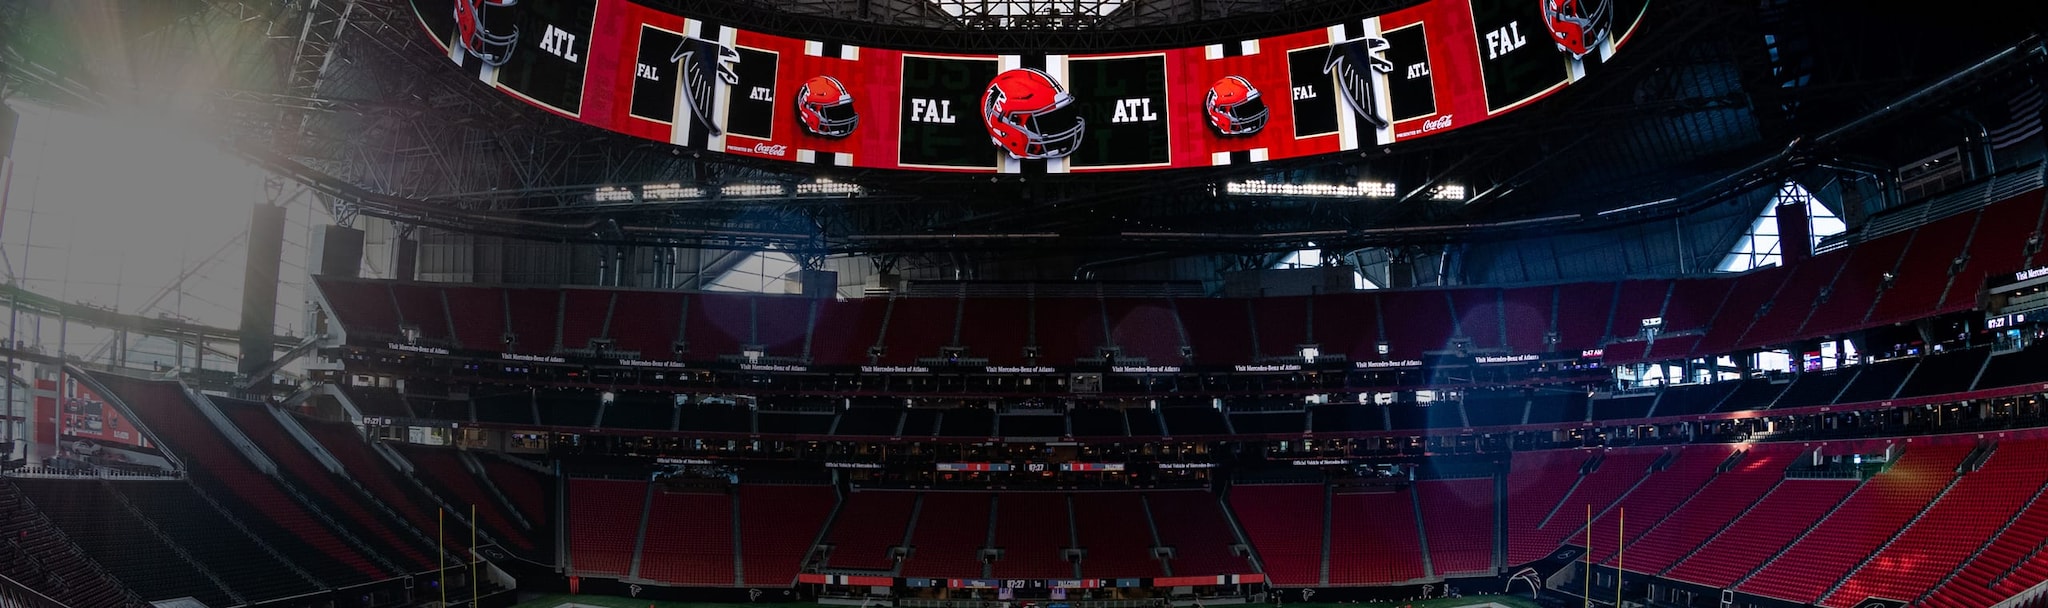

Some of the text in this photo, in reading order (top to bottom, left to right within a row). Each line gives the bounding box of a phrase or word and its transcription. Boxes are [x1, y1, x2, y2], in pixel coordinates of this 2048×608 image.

[539, 23, 578, 63] ATL
[1486, 20, 1526, 60] FAL
[637, 62, 659, 81] FAL
[1407, 62, 1429, 79] ATL
[749, 86, 773, 102] ATL
[1293, 85, 1317, 101] FAL
[911, 98, 956, 123] FAL
[1112, 97, 1157, 123] ATL
